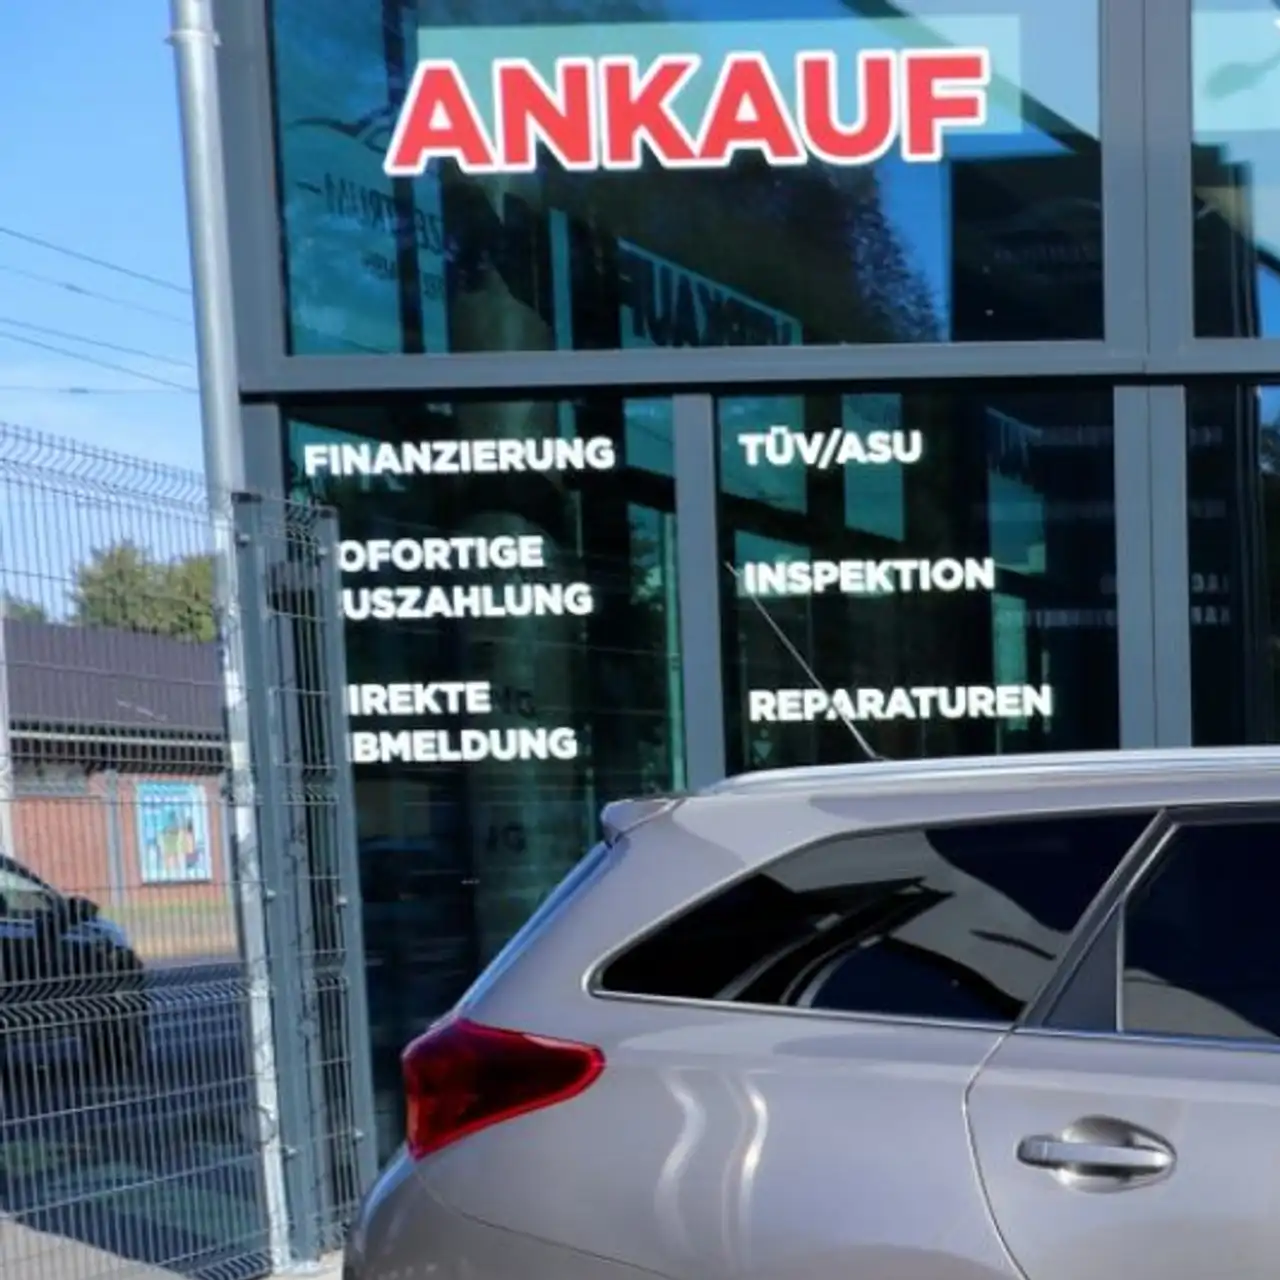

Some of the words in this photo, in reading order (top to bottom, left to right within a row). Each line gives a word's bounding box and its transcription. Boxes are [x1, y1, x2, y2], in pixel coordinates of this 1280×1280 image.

[385, 48, 989, 175] ANKAUF
[304, 437, 616, 475] FINANZIERUNG
[739, 427, 922, 469] TÜV/ASU
[336, 535, 545, 573] OFORTIGE
[744, 558, 995, 593] INSPEKTION
[338, 582, 594, 620] USZAHLUNG
[342, 681, 492, 716] IREKTE
[750, 685, 1052, 722] REPARATUREN
[345, 727, 578, 764] BMELDUNG
